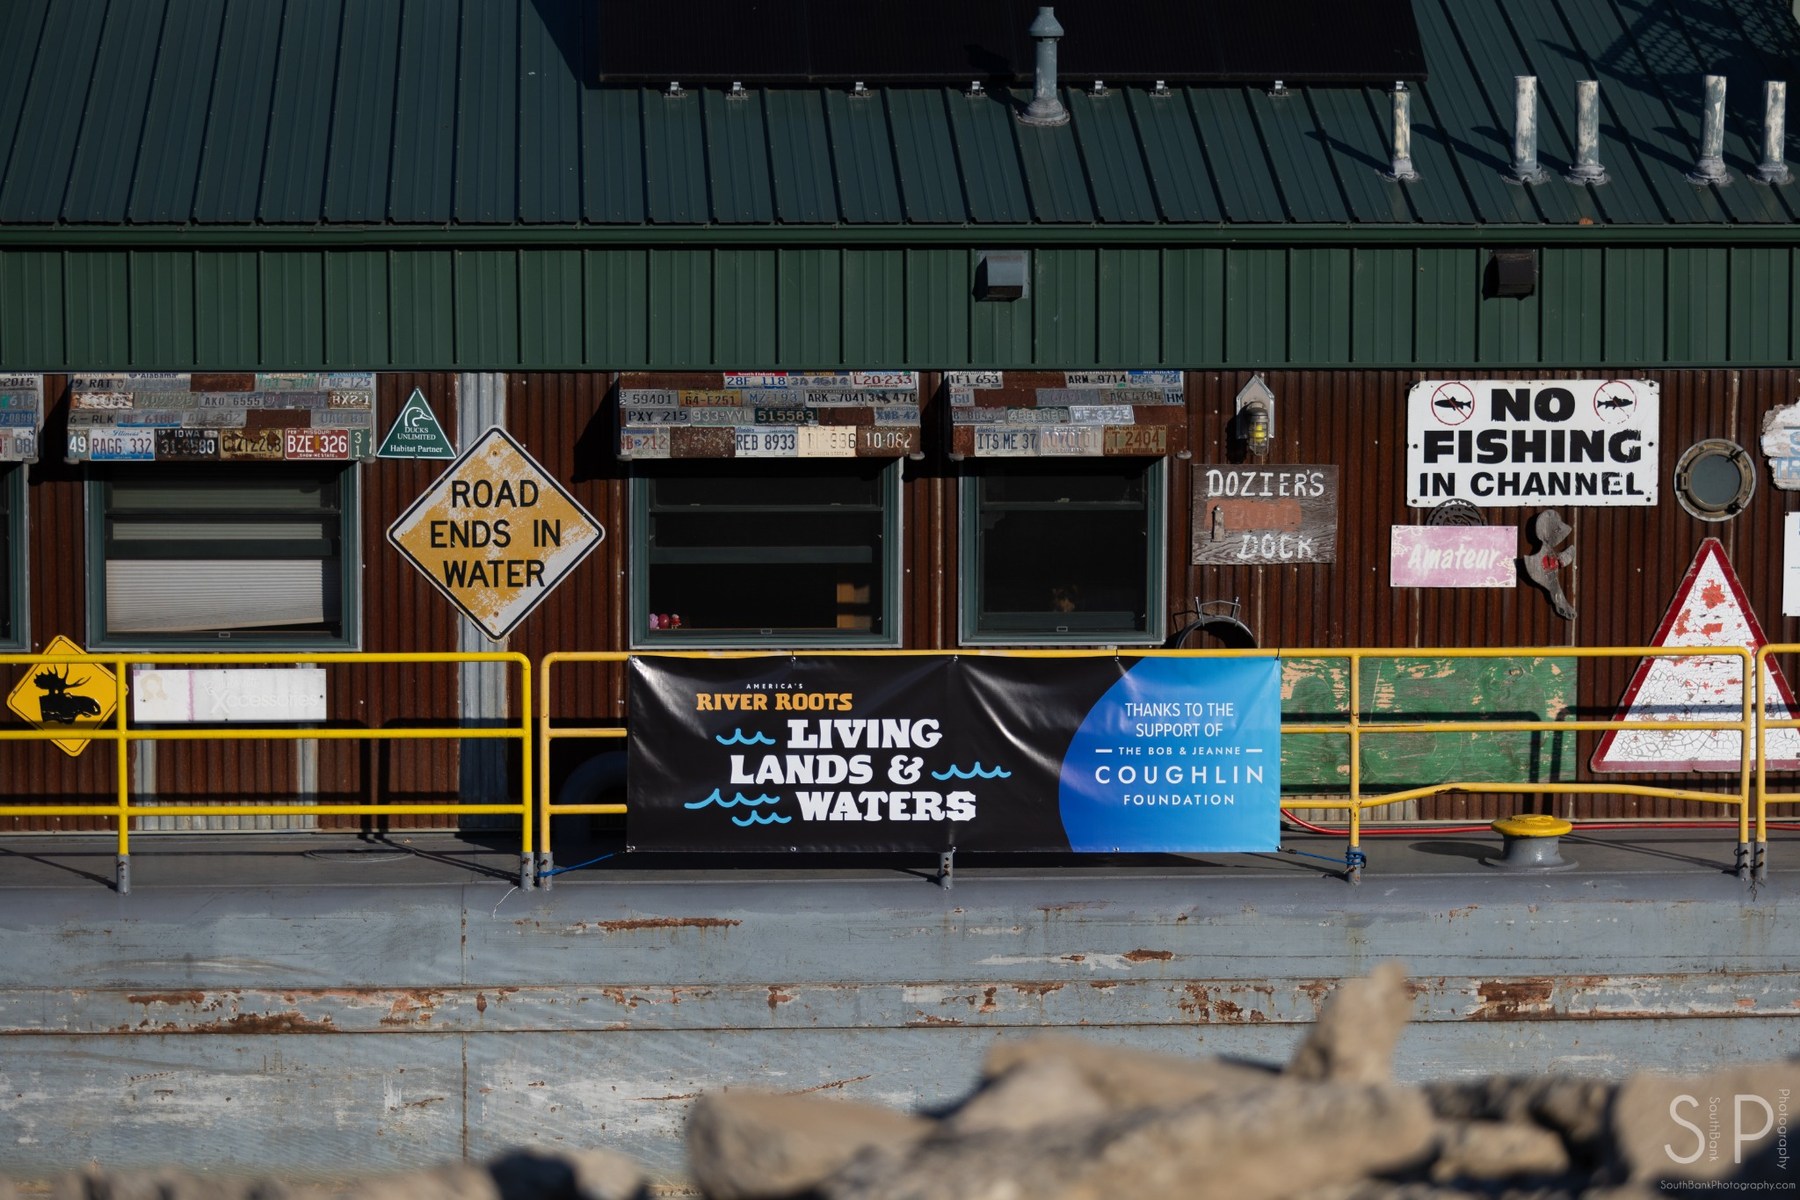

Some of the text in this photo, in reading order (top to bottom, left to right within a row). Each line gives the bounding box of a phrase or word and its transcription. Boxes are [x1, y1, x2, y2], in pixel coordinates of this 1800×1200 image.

[1491, 387, 1576, 423] NO
[628, 411, 688, 422] PXY 215
[758, 410, 815, 422] 515583
[174, 429, 201, 439] IOWA
[736, 434, 759, 450] REB
[765, 434, 796, 450] 8933
[978, 433, 1037, 450] ITS ME 37
[1112, 431, 1161, 447] T 2404
[69, 436, 87, 453] 49
[92, 438, 153, 456] RAGG 332
[287, 435, 348, 454] BZE 326
[390, 445, 444, 453] Habitat Partner
[1423, 429, 1642, 464] FISHING
[1206, 469, 1325, 497] DOZIER'S
[1419, 471, 1645, 497] IN CHANNEL
[452, 480, 539, 508] ROAD
[431, 519, 561, 548] ENDS IN
[1236, 533, 1313, 559] DOCK
[1407, 543, 1501, 570] Amateur
[443, 559, 545, 588] WATER
[696, 693, 853, 711] RIVER ROOTS
[1125, 703, 1235, 717] THANKS TO THE
[787, 718, 943, 749] LIVING
[1136, 723, 1223, 737] SUPPORT OF
[1118, 747, 1241, 756] THE BOB & JEANNE
[730, 755, 924, 785] LANDS &
[1095, 766, 1263, 784] COUGHLIN
[795, 791, 977, 822] WATERS
[1123, 794, 1235, 806] FOUNDATION
